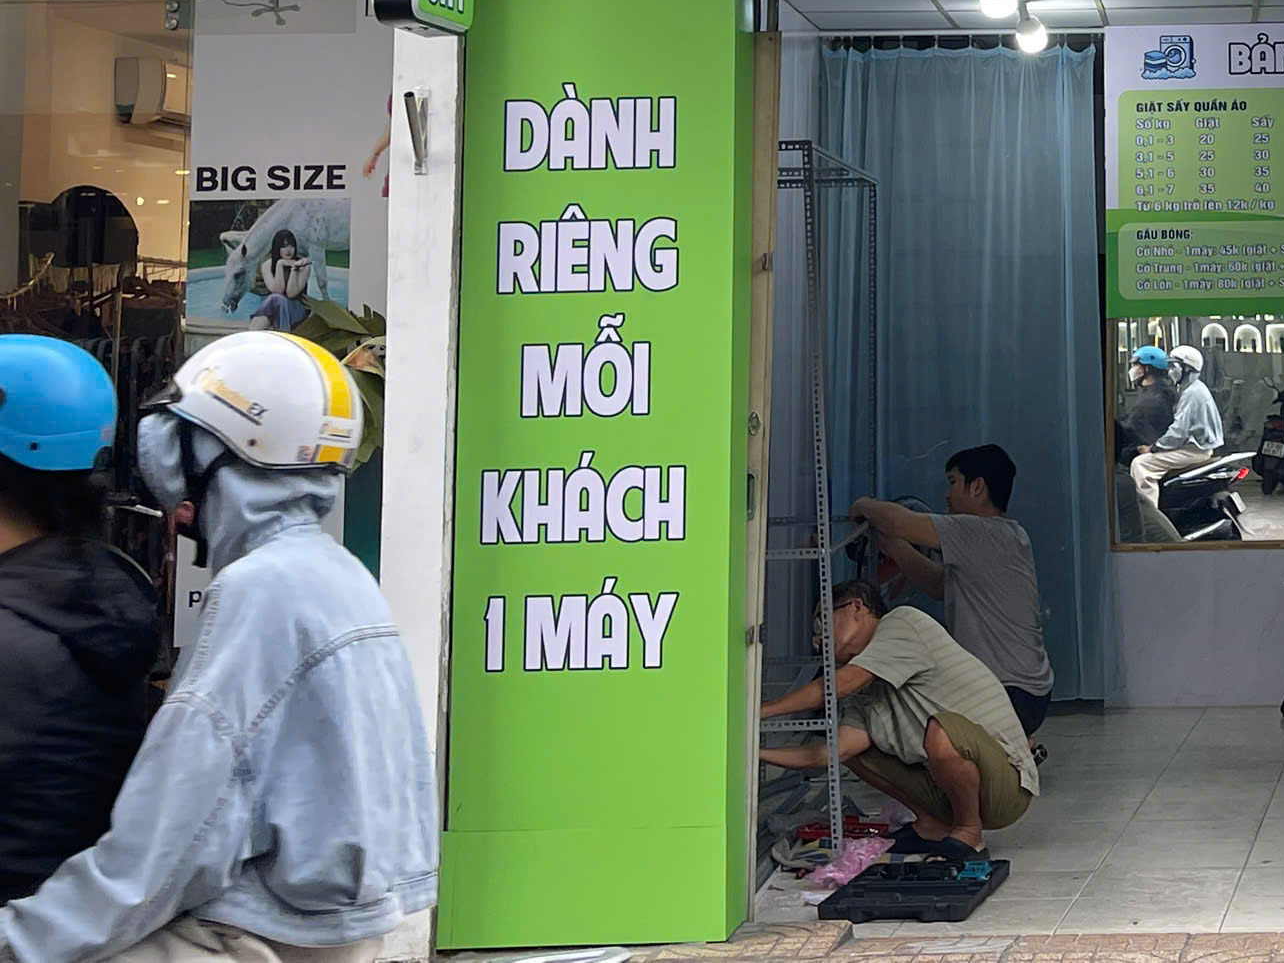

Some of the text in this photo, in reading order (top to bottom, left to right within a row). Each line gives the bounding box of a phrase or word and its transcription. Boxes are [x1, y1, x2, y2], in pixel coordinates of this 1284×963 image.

[1136, 102, 1163, 114] GIẶT
[1167, 100, 1190, 112] SẤY
[1231, 99, 1247, 111] ÁO
[503, 82, 677, 172] DÀNH
[1155, 118, 1170, 130] kg
[1200, 134, 1215, 144] 20
[1254, 133, 1269, 144] 25
[1200, 151, 1215, 161] 25
[1255, 150, 1270, 160] 30
[195, 164, 347, 192] BIG SIZE
[1199, 167, 1215, 177] 30
[1255, 166, 1270, 176] 35
[1200, 184, 1215, 194] 35
[1255, 183, 1270, 193] 40
[496, 203, 679, 295] RIÊNG
[519, 313, 652, 419] MỖI
[479, 451, 686, 546] KHÁCH
[483, 576, 679, 673] 1 MÁY
